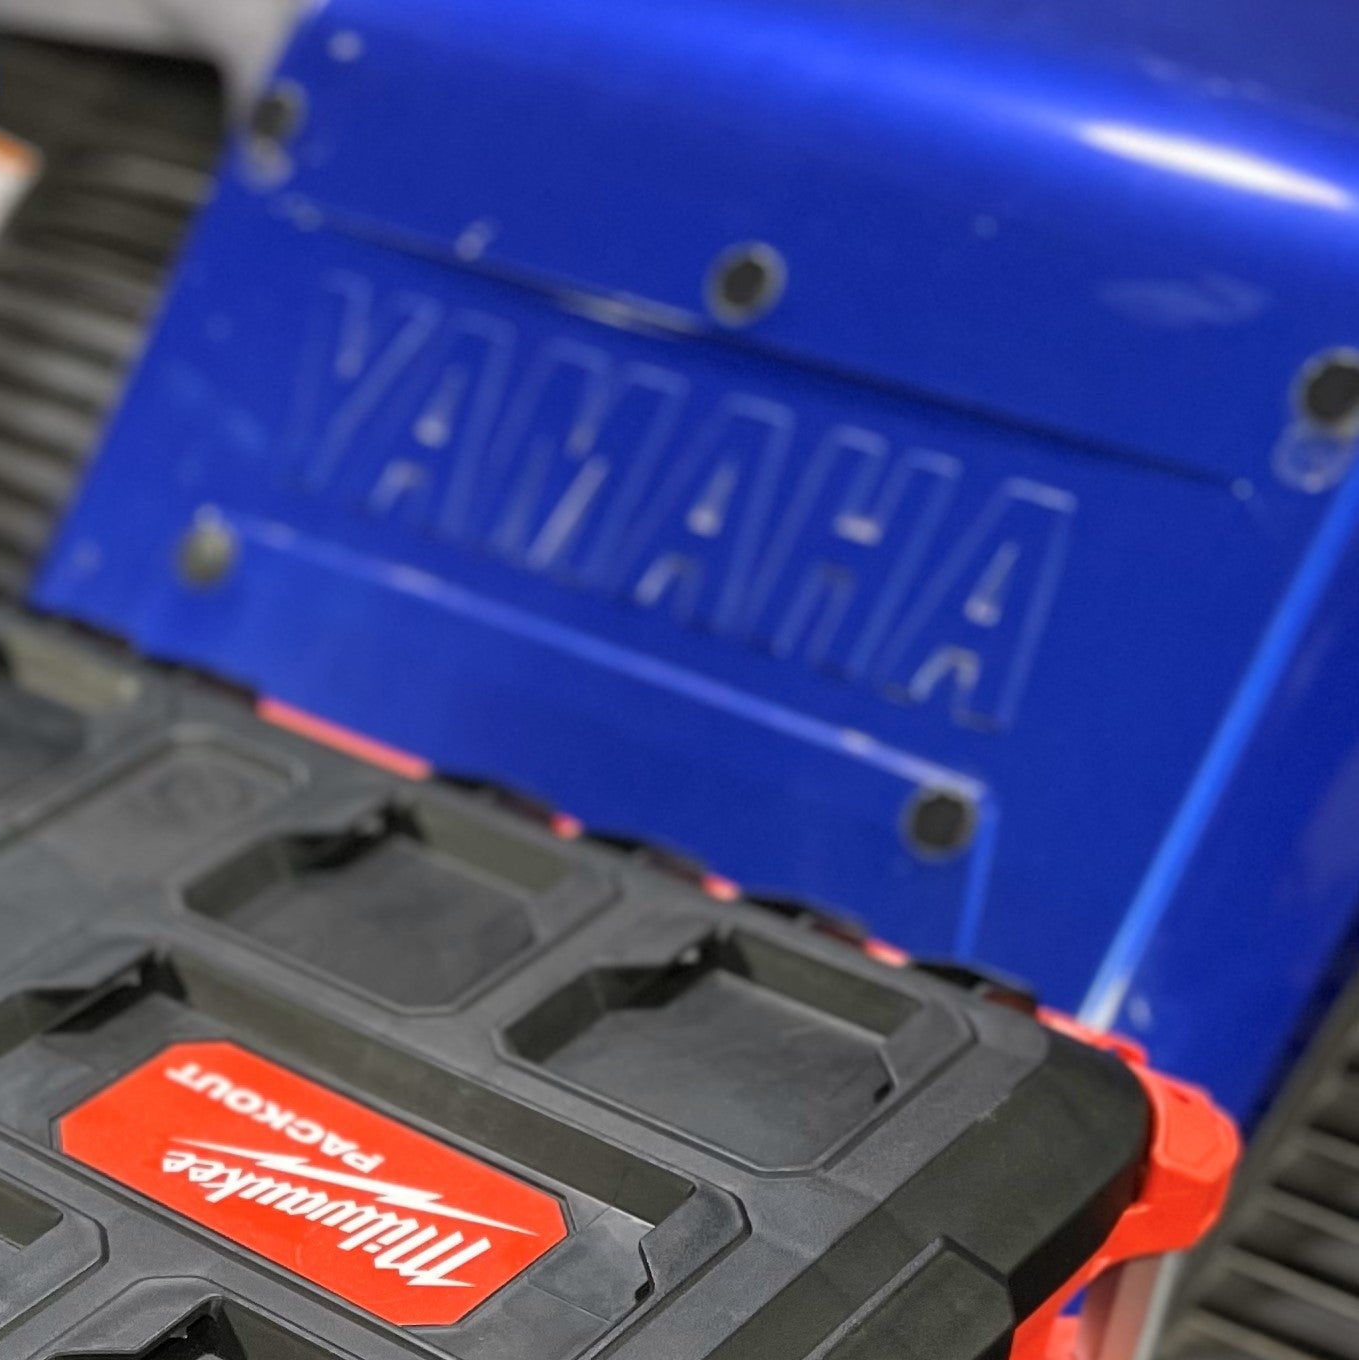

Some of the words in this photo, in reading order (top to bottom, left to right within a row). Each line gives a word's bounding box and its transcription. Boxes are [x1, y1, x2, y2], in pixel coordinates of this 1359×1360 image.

[288, 266, 1079, 732] YAMAHA
[165, 1062, 386, 1174] PACKOUT
[161, 1150, 492, 1287] Milwaukee
